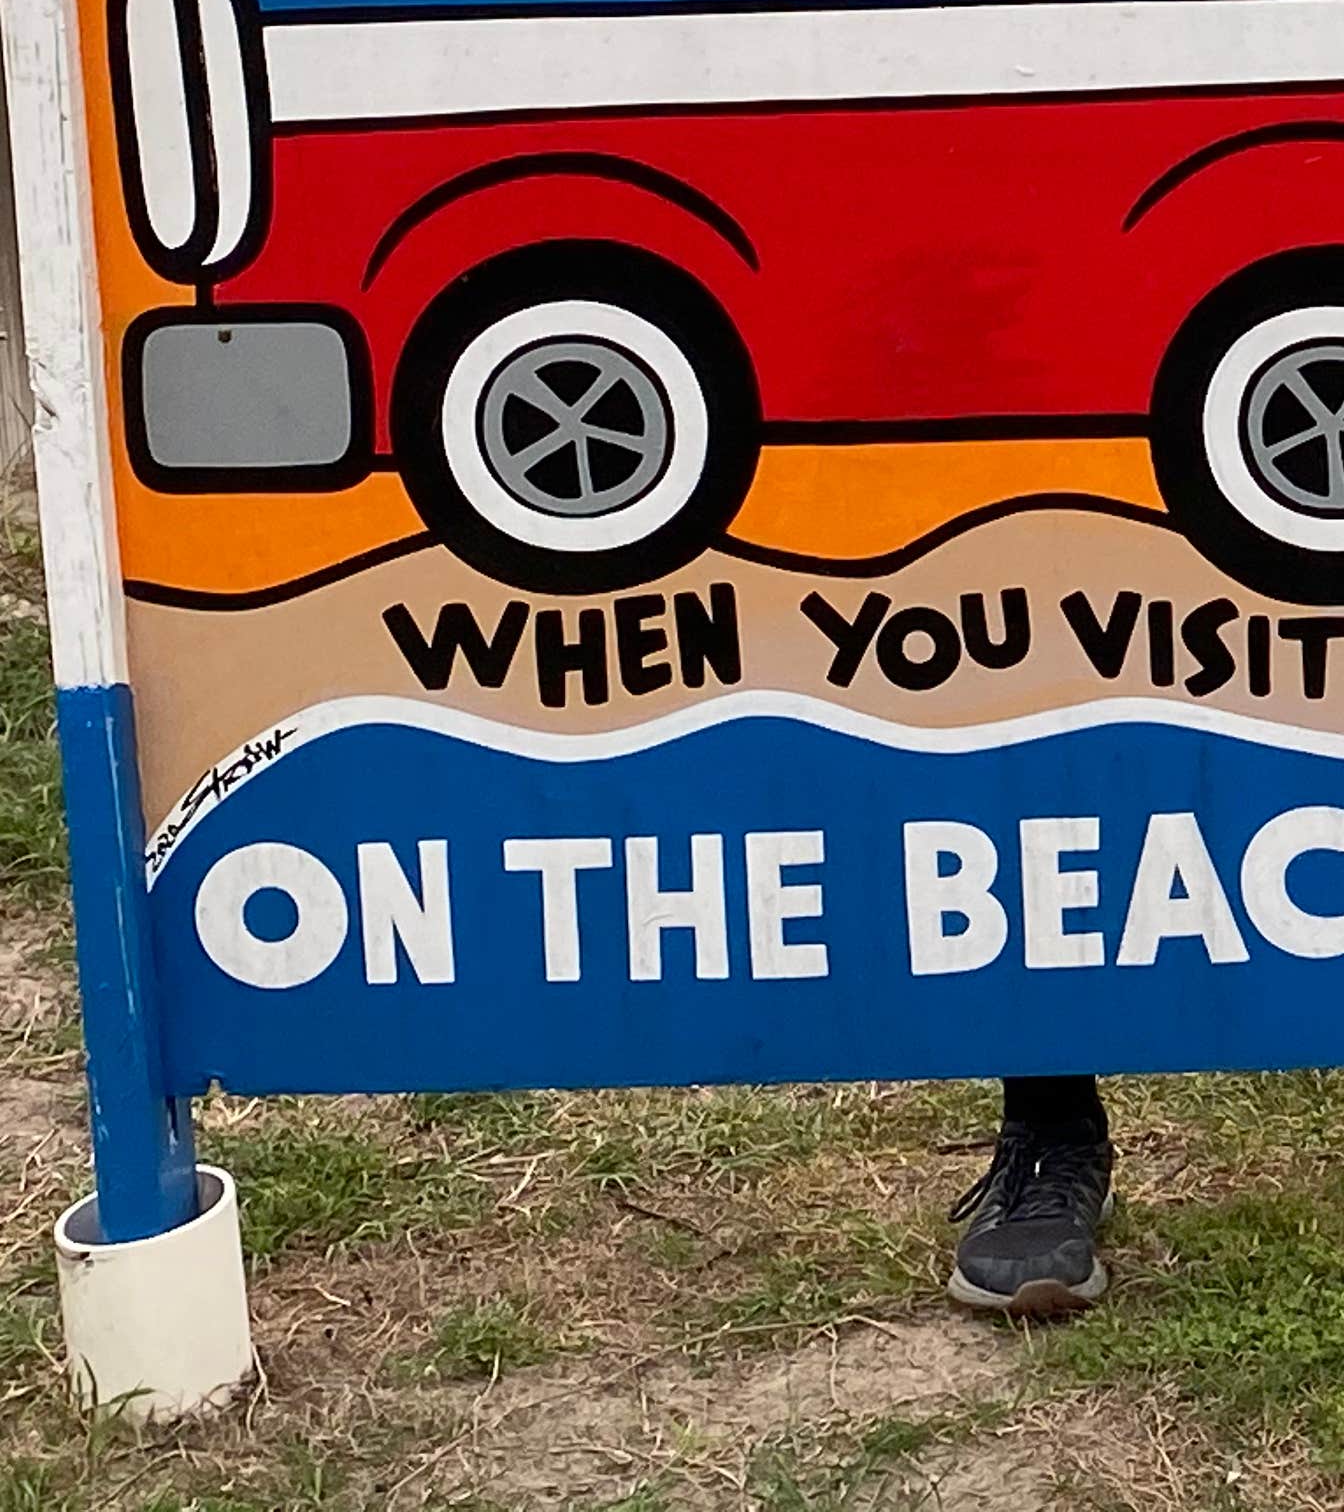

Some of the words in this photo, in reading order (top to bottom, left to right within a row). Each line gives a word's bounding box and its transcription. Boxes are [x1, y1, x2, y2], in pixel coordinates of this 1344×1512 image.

[382, 583, 742, 707] WHEN
[800, 587, 1031, 691] YOU
[195, 840, 455, 988] ON
[504, 831, 829, 981] THE
